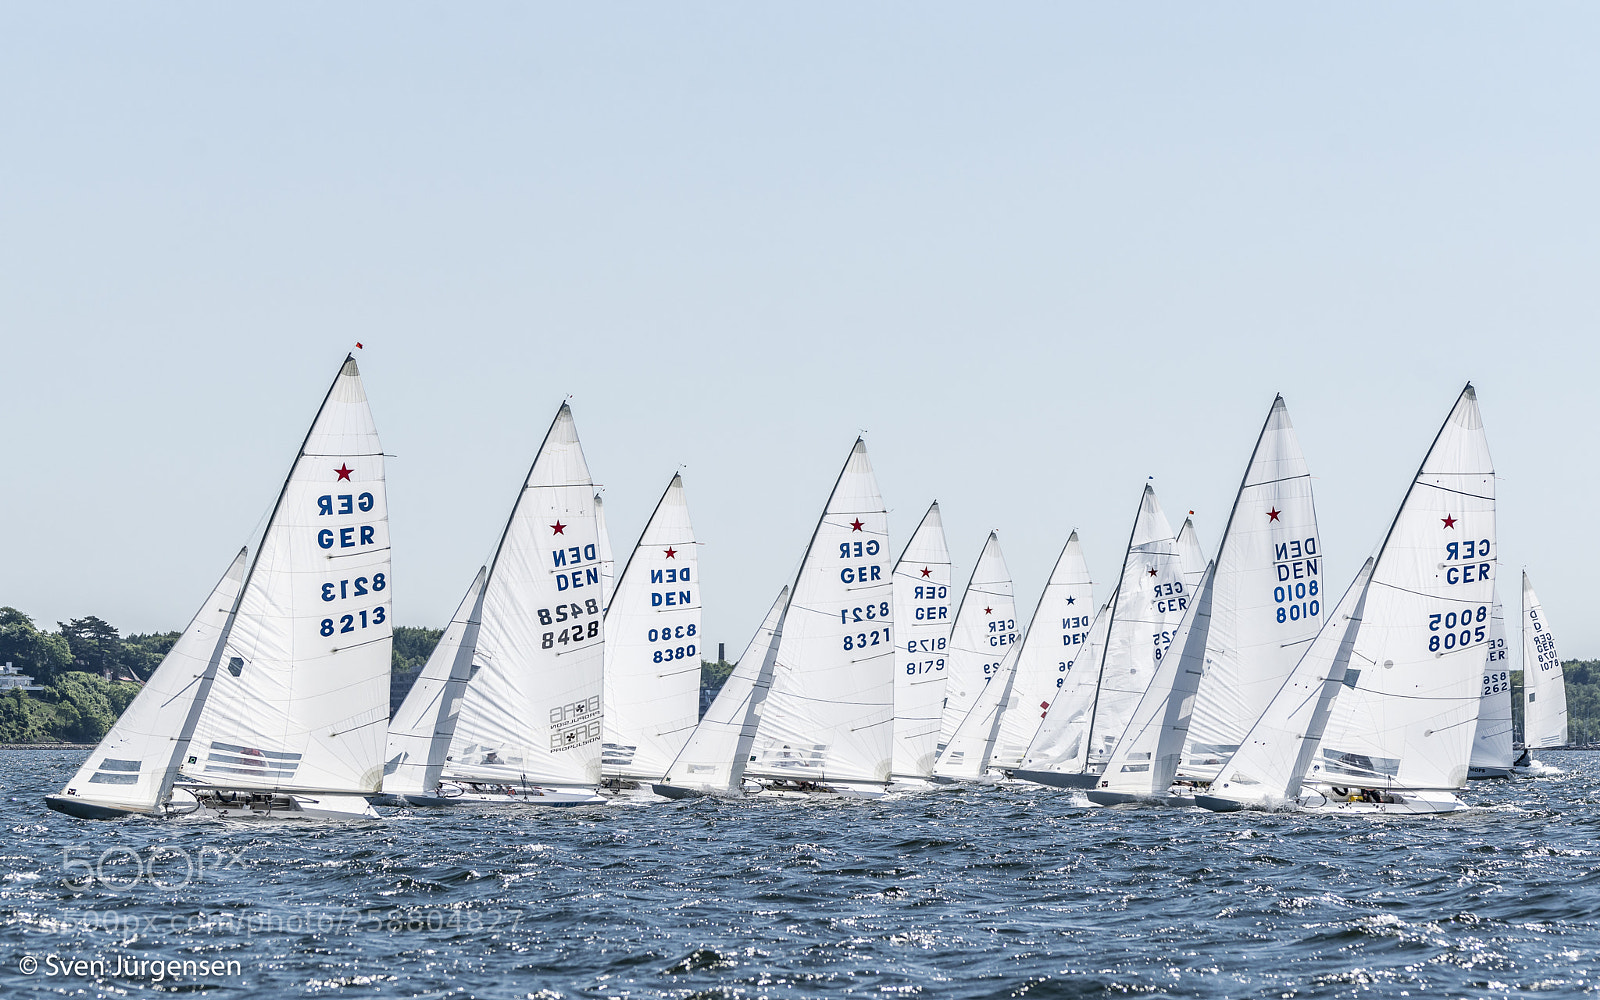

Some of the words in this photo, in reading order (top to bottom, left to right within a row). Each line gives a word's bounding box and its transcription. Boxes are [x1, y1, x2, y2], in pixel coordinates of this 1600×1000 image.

[317, 525, 375, 549] GER
[556, 567, 599, 591] DEN
[840, 565, 881, 584] GER
[1277, 558, 1318, 582] DEN
[1446, 563, 1491, 585] GER
[651, 590, 691, 607] DEN
[1157, 598, 1187, 614] GER
[915, 606, 948, 620] GER
[1276, 600, 1320, 623] 8010
[320, 606, 386, 637] 8213
[541, 620, 599, 649] 8428
[843, 627, 890, 651] 8321
[990, 633, 1016, 647] GER
[1428, 625, 1486, 652] 8005
[653, 644, 696, 663] 8380
[1486, 650, 1505, 662] ER
[1537, 641, 1555, 653] GER
[906, 658, 945, 675] 8179
[1540, 659, 1559, 671] 1078
